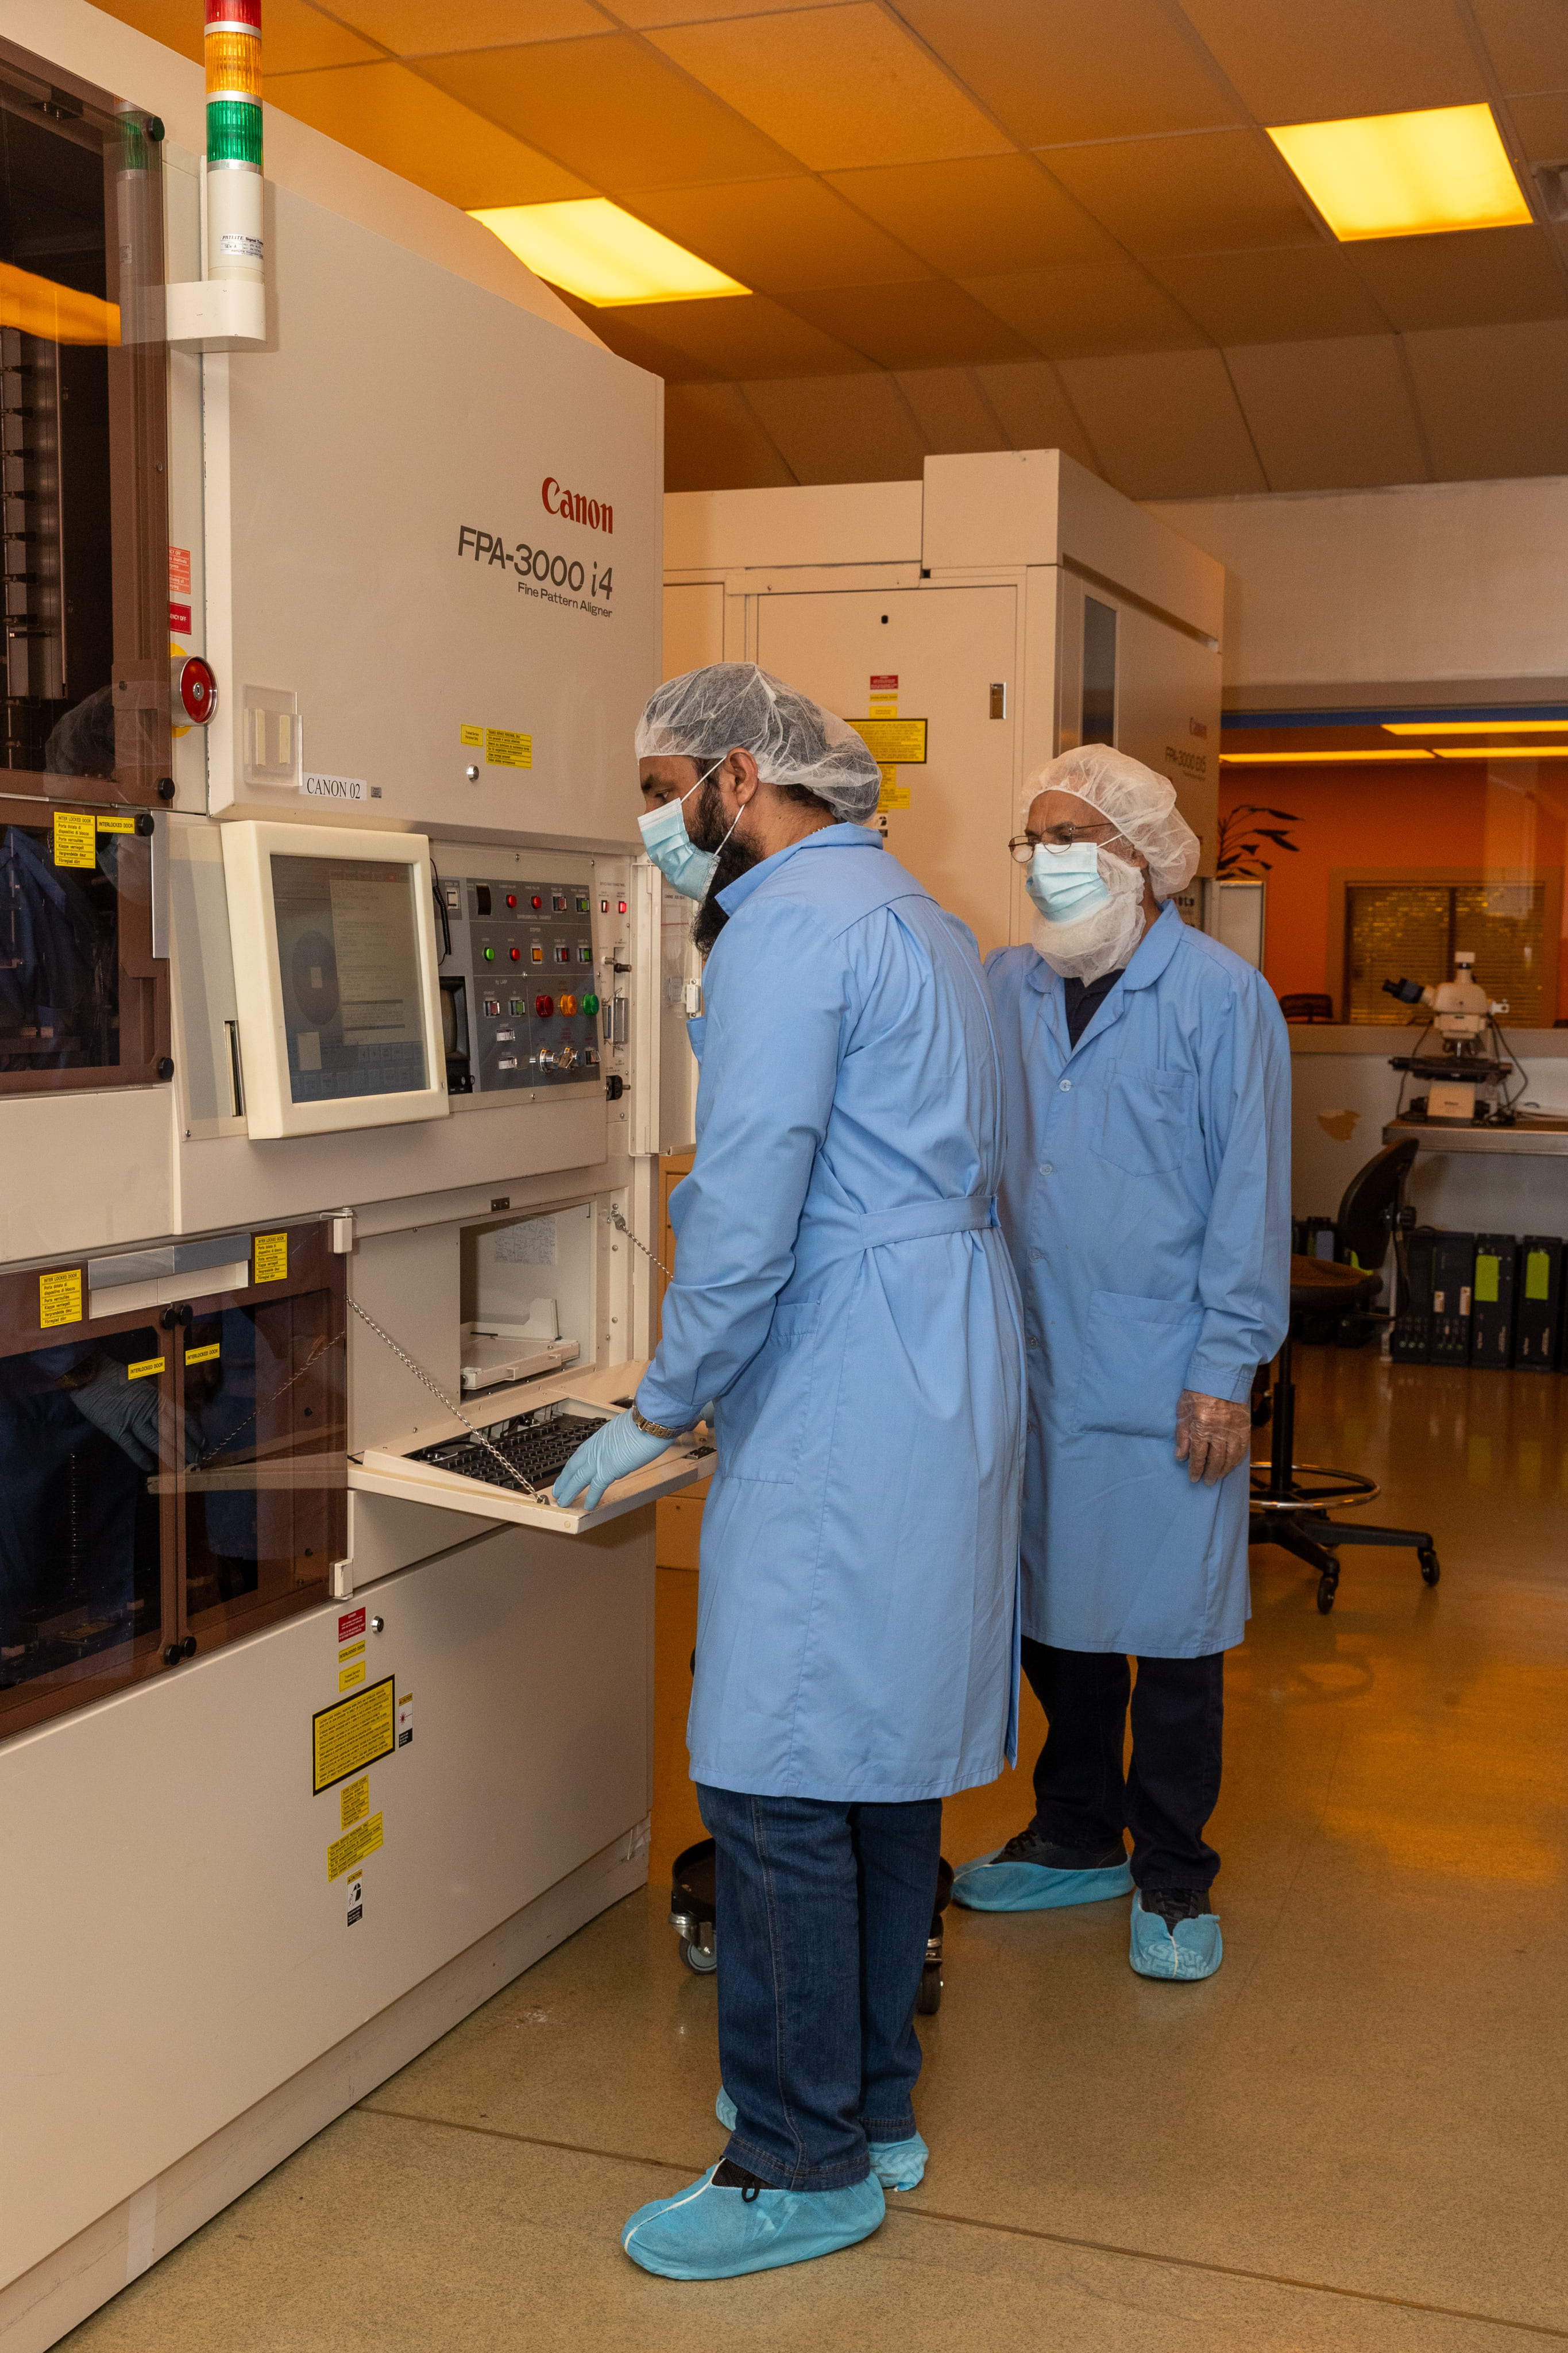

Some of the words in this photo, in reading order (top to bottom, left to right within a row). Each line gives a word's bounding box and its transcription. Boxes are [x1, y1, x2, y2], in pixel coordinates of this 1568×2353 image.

[542, 477, 613, 534] Canon
[458, 525, 585, 591] FPA-3000
[591, 561, 613, 600] i4
[518, 581, 539, 597] Fine
[540, 588, 578, 608] Pattern
[580, 600, 613, 618] Aligner
[307, 777, 347, 797] CANON
[350, 782, 361, 799] 02
[130, 1365, 153, 1374] INTERLOCKED
[187, 1351, 208, 1360] INTERLOCKED
